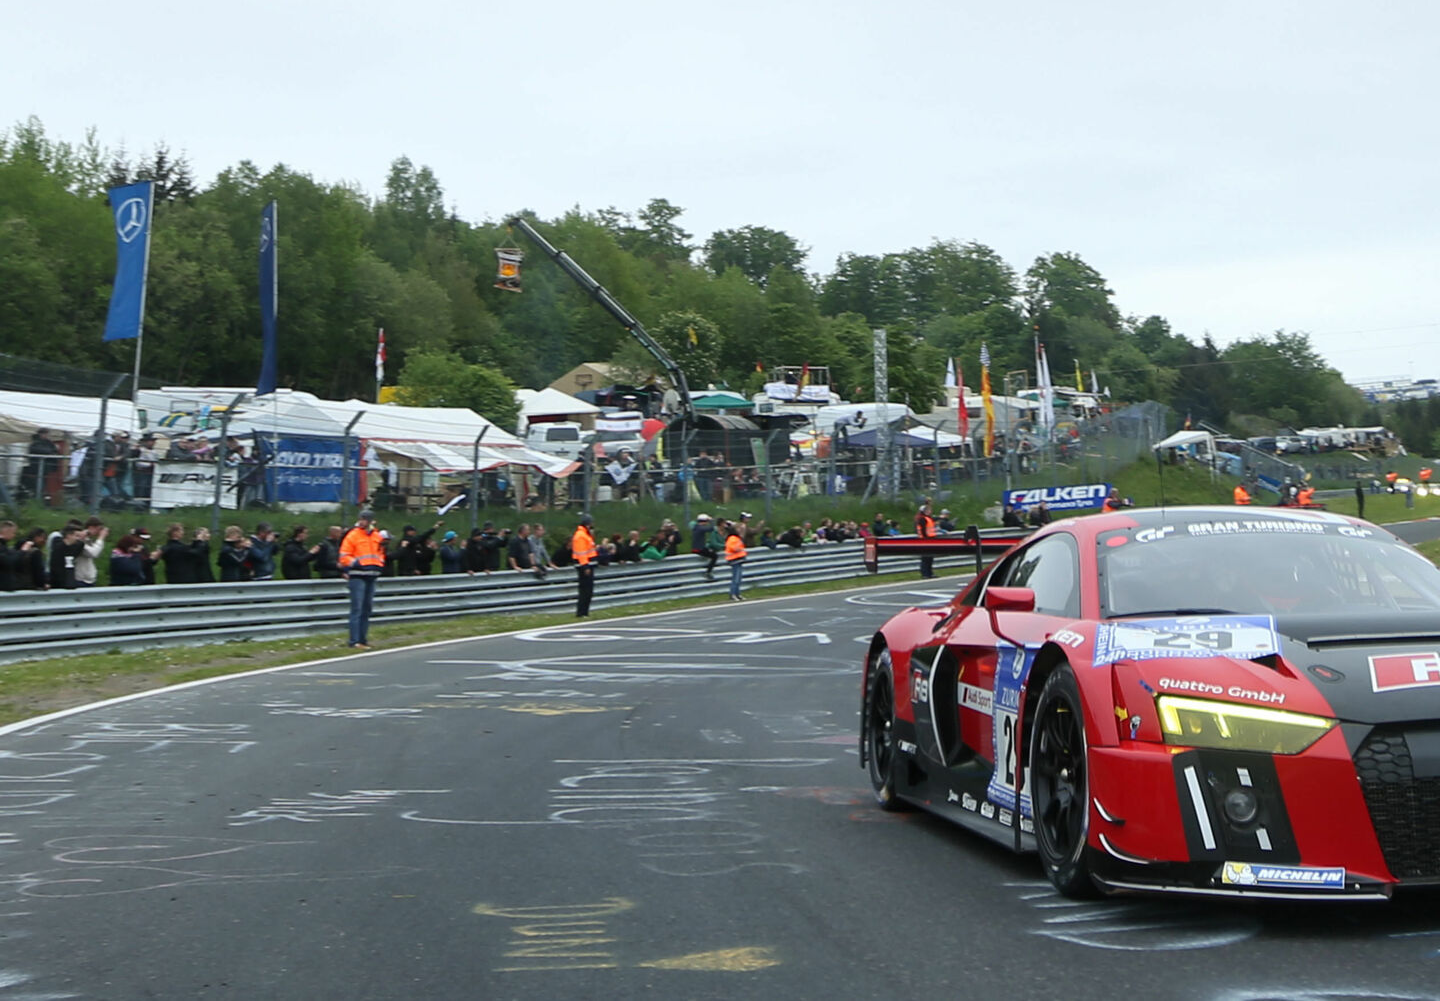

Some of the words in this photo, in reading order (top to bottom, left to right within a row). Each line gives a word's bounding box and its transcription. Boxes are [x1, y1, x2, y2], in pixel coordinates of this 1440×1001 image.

[1009, 484, 1106, 504] FALKEN
[1188, 521, 1239, 534] GRAN
[1242, 520, 1324, 533] TURISMO
[1049, 629, 1085, 648] KEN
[1153, 630, 1233, 651] 29
[1159, 677, 1224, 695] quattro
[1228, 686, 1286, 704] GmbH
[1258, 868, 1342, 881] MICHELIN
